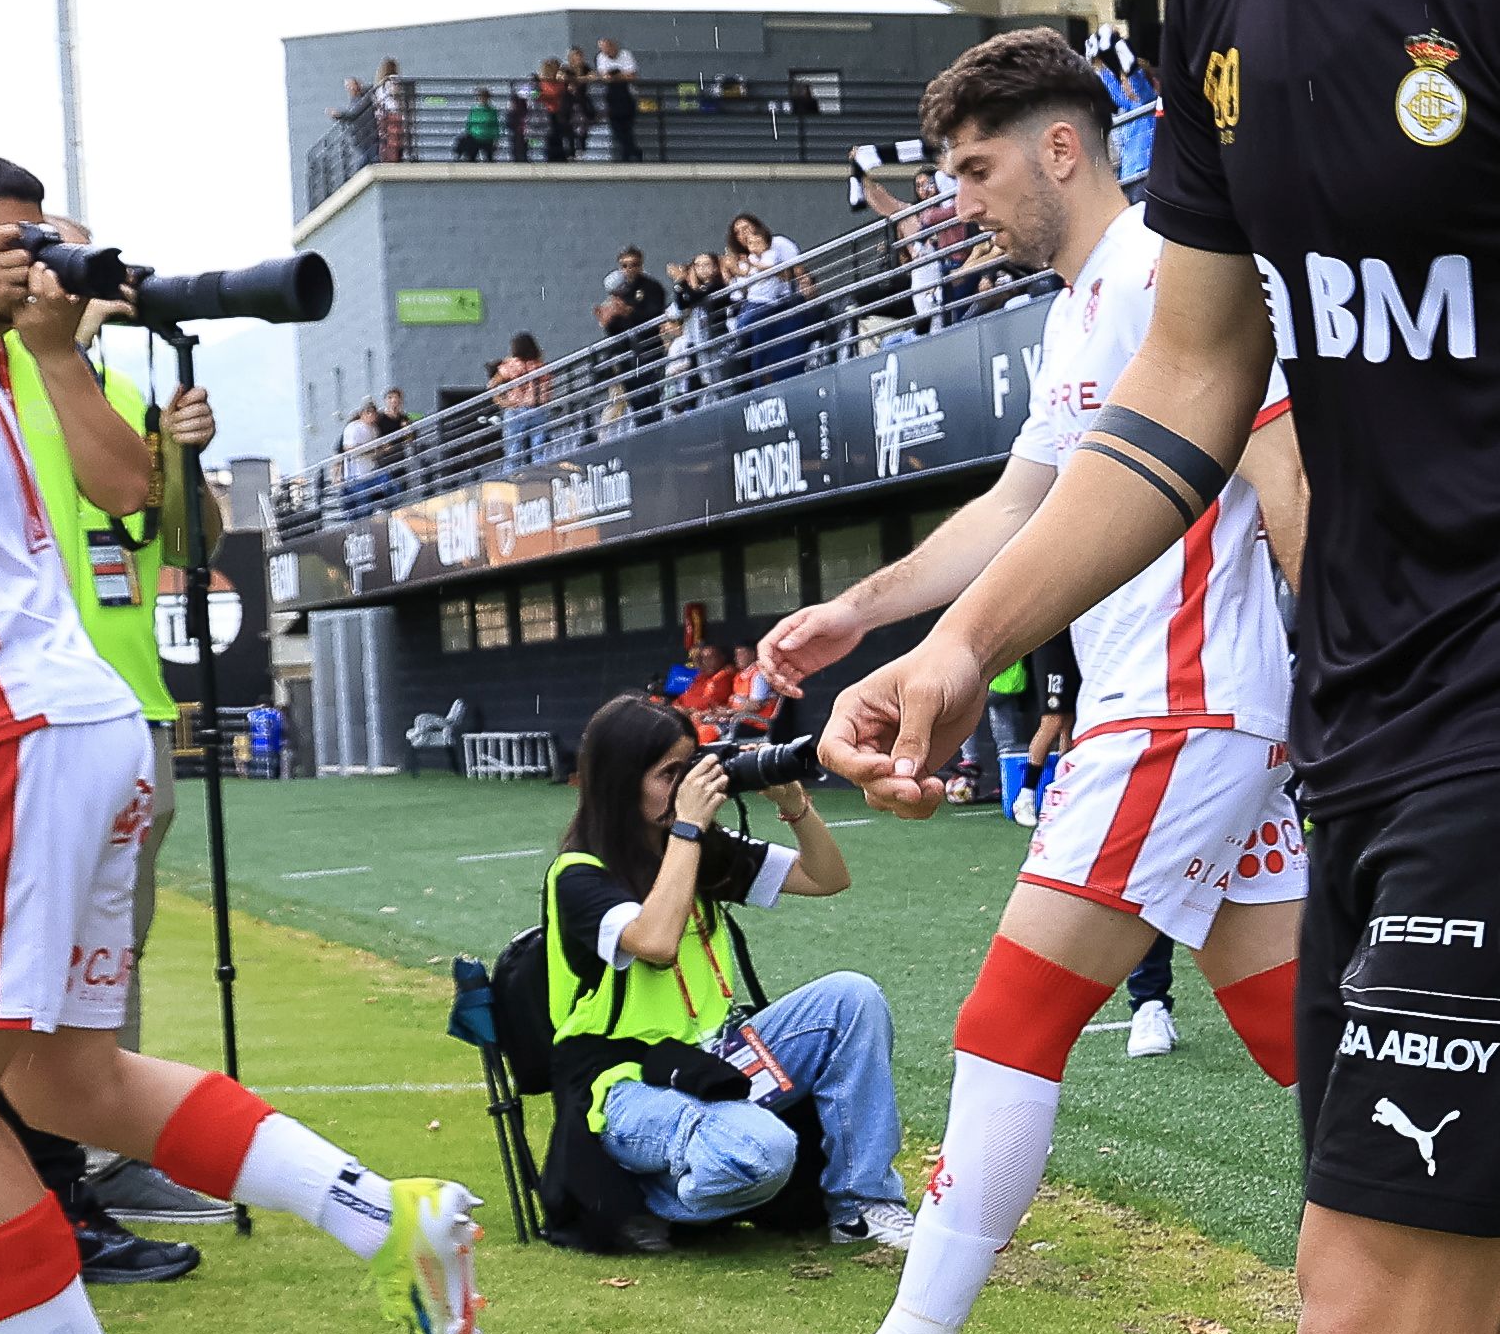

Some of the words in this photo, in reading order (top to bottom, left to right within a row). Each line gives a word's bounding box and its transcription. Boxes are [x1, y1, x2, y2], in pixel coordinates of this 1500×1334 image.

[1305, 251, 1477, 364] BM
[1047, 673, 1064, 694] 12
[1368, 915, 1486, 949] TESA
[1375, 1029, 1500, 1074] ABLOY
